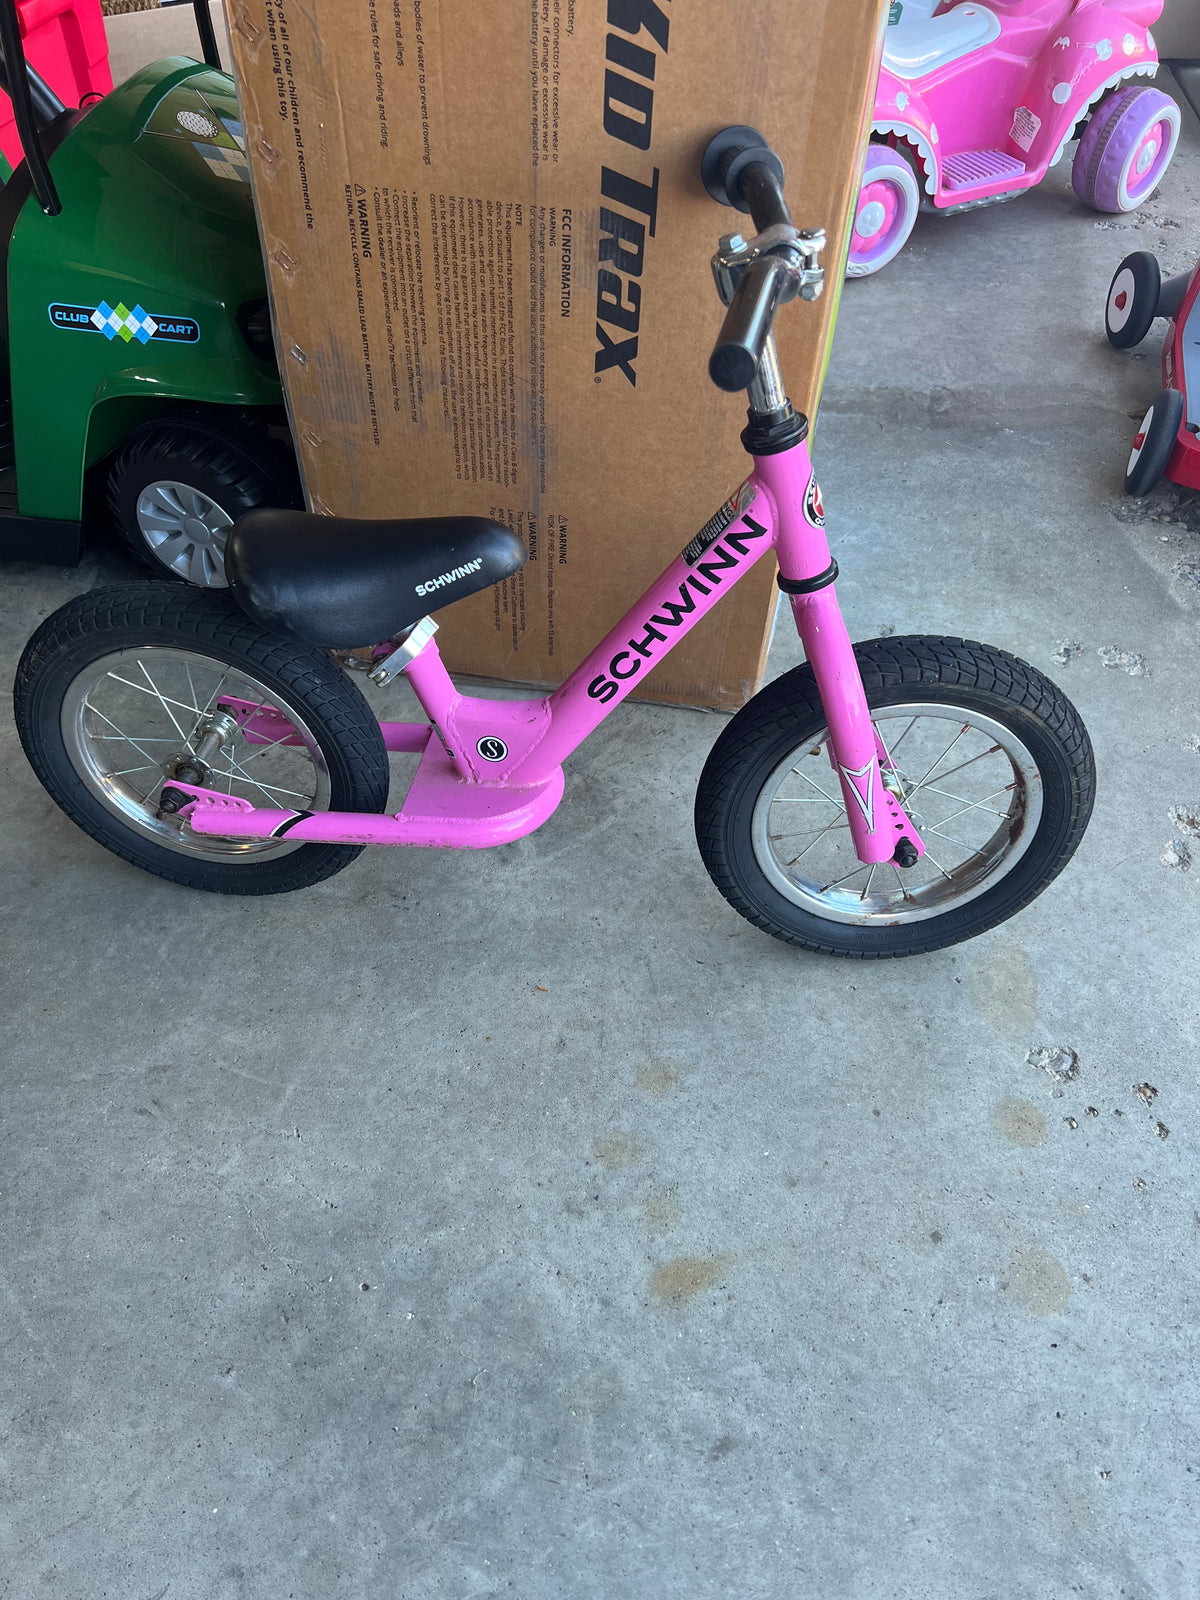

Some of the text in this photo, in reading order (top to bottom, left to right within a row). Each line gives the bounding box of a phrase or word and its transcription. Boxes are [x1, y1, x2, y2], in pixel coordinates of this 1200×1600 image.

[266, 9, 281, 41] when
[278, 12, 288, 24] of
[370, 10, 381, 33] rules
[395, 20, 405, 38] and
[529, 11, 540, 46] battery
[280, 27, 290, 41] all
[372, 35, 383, 49] for
[553, 17, 561, 69] connectors
[268, 44, 285, 74] using
[282, 44, 292, 56] of
[373, 50, 384, 70] safe
[394, 40, 407, 66] alleys
[532, 48, 540, 69] until
[540, 35, 551, 73] damage
[284, 58, 293, 78] our
[530, 70, 538, 88] you
[553, 71, 561, 85] for
[275, 77, 289, 98] this
[372, 71, 387, 102] driving
[414, 0, 433, 165] bodies of water to prevent drownings
[542, 76, 548, 85] or
[276, 100, 291, 121] toy.
[288, 80, 302, 125] children
[532, 90, 541, 112] have
[542, 88, 551, 129] excessive
[552, 87, 561, 128] excessive
[378, 104, 389, 121] and
[294, 128, 305, 148] and
[530, 113, 541, 151] replaced
[532, 153, 541, 167] the
[552, 154, 558, 162] or
[297, 150, 314, 210] recommend
[383, 188, 390, 196] to
[374, 192, 384, 221] Consult
[384, 198, 394, 221] which
[392, 194, 403, 226] Connect
[402, 195, 412, 228] Increase
[411, 196, 421, 230] Reorient
[305, 213, 316, 229] the
[358, 198, 372, 258] WARNING
[376, 223, 386, 236] the
[386, 222, 395, 235] the
[395, 227, 404, 240] the
[405, 229, 413, 242] the
[414, 230, 420, 240] or
[378, 237, 388, 261] dealer
[387, 236, 397, 266] receiver
[414, 241, 424, 270] relocate
[352, 252, 362, 288] CONTAINS
[380, 262, 387, 270] or
[394, 241, 407, 281] equipment
[404, 243, 415, 282] separation
[560, 209, 572, 317] FCC INFORMATION
[381, 271, 388, 281] an
[416, 272, 425, 284] the
[400, 282, 408, 296] into
[409, 283, 419, 314] between
[357, 290, 365, 314] SEALED
[380, 282, 394, 324] experienced
[401, 297, 408, 307] an
[415, 285, 427, 316] receiving
[54, 310, 195, 336] CLUB CART
[402, 308, 412, 328] outlet
[411, 314, 420, 326] the
[386, 325, 397, 353] radio/TV
[404, 329, 410, 338] on
[405, 345, 414, 366] circuit
[410, 327, 422, 364] equipment
[365, 364, 374, 390] BATTERY
[389, 354, 400, 386] technician
[407, 366, 418, 393] different
[415, 364, 424, 377] and
[368, 391, 376, 408] MUST
[392, 387, 401, 397] for
[410, 394, 419, 409] from
[411, 410, 420, 423] that
[559, 525, 567, 565] WARNING
[587, 514, 768, 704] SCHWINN
